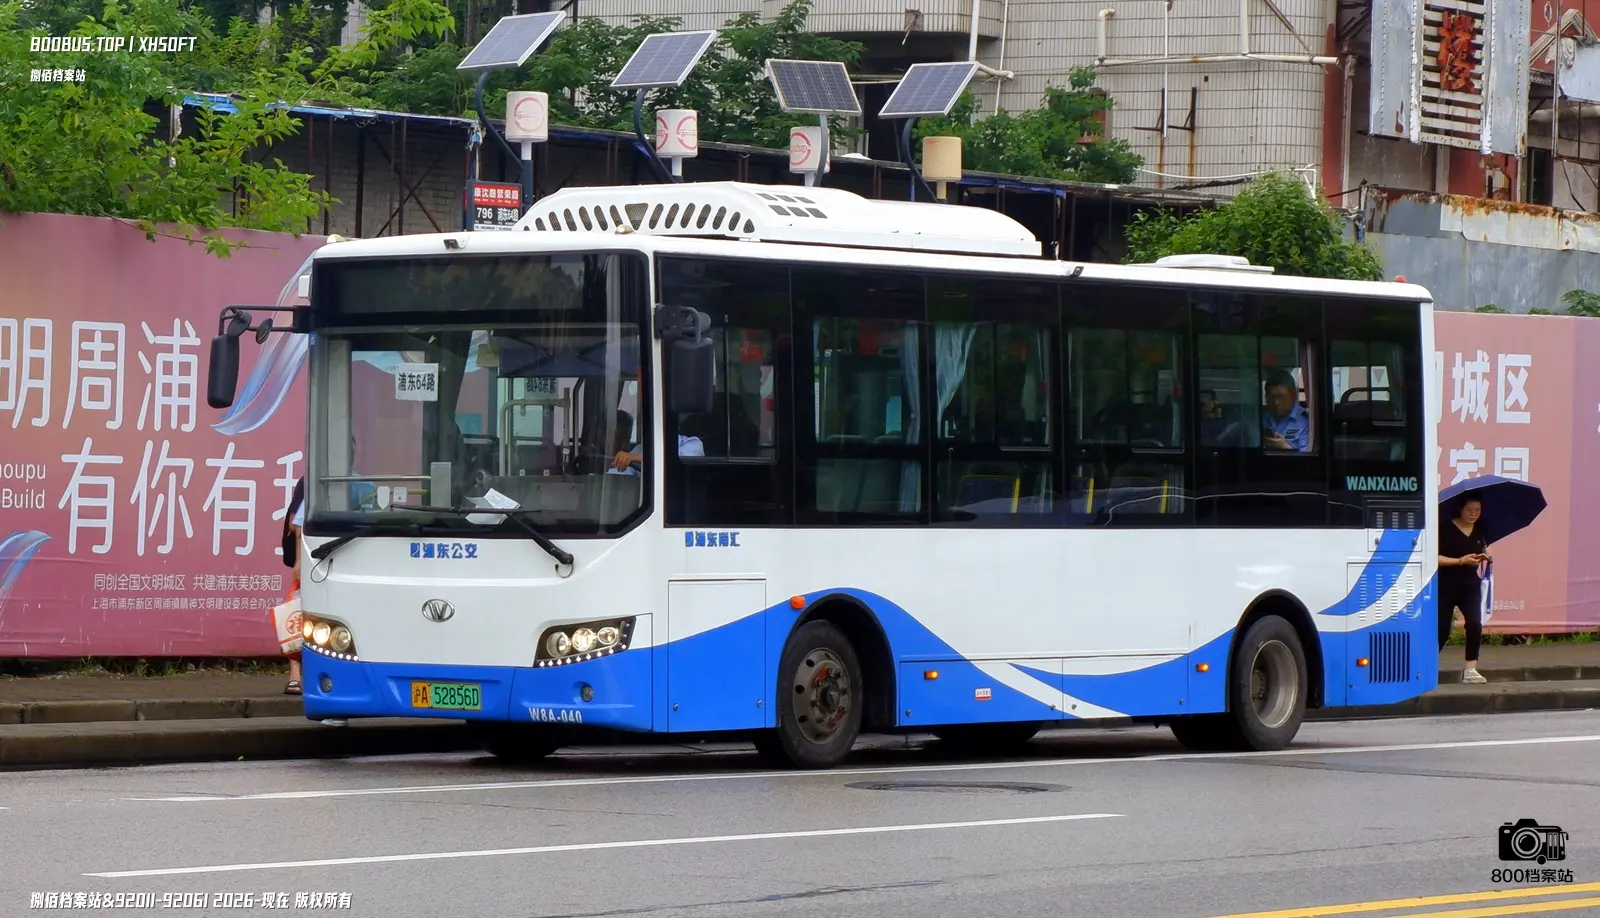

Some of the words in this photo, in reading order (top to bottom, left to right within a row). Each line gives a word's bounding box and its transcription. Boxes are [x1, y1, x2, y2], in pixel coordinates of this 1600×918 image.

[477, 207, 493, 219] 796
[398, 372, 435, 392] 浦东64路
[1436, 349, 1532, 425] 城区
[1346, 476, 1418, 492] WANXIANG
[2, 488, 45, 509] Build
[695, 530, 741, 548] 浦东南汇
[423, 542, 478, 559] 浦东公交
[94, 573, 186, 592] 同创全国文明城区
[192, 573, 283, 592] 共建浦东美好家园
[528, 707, 583, 725] W8A-040
